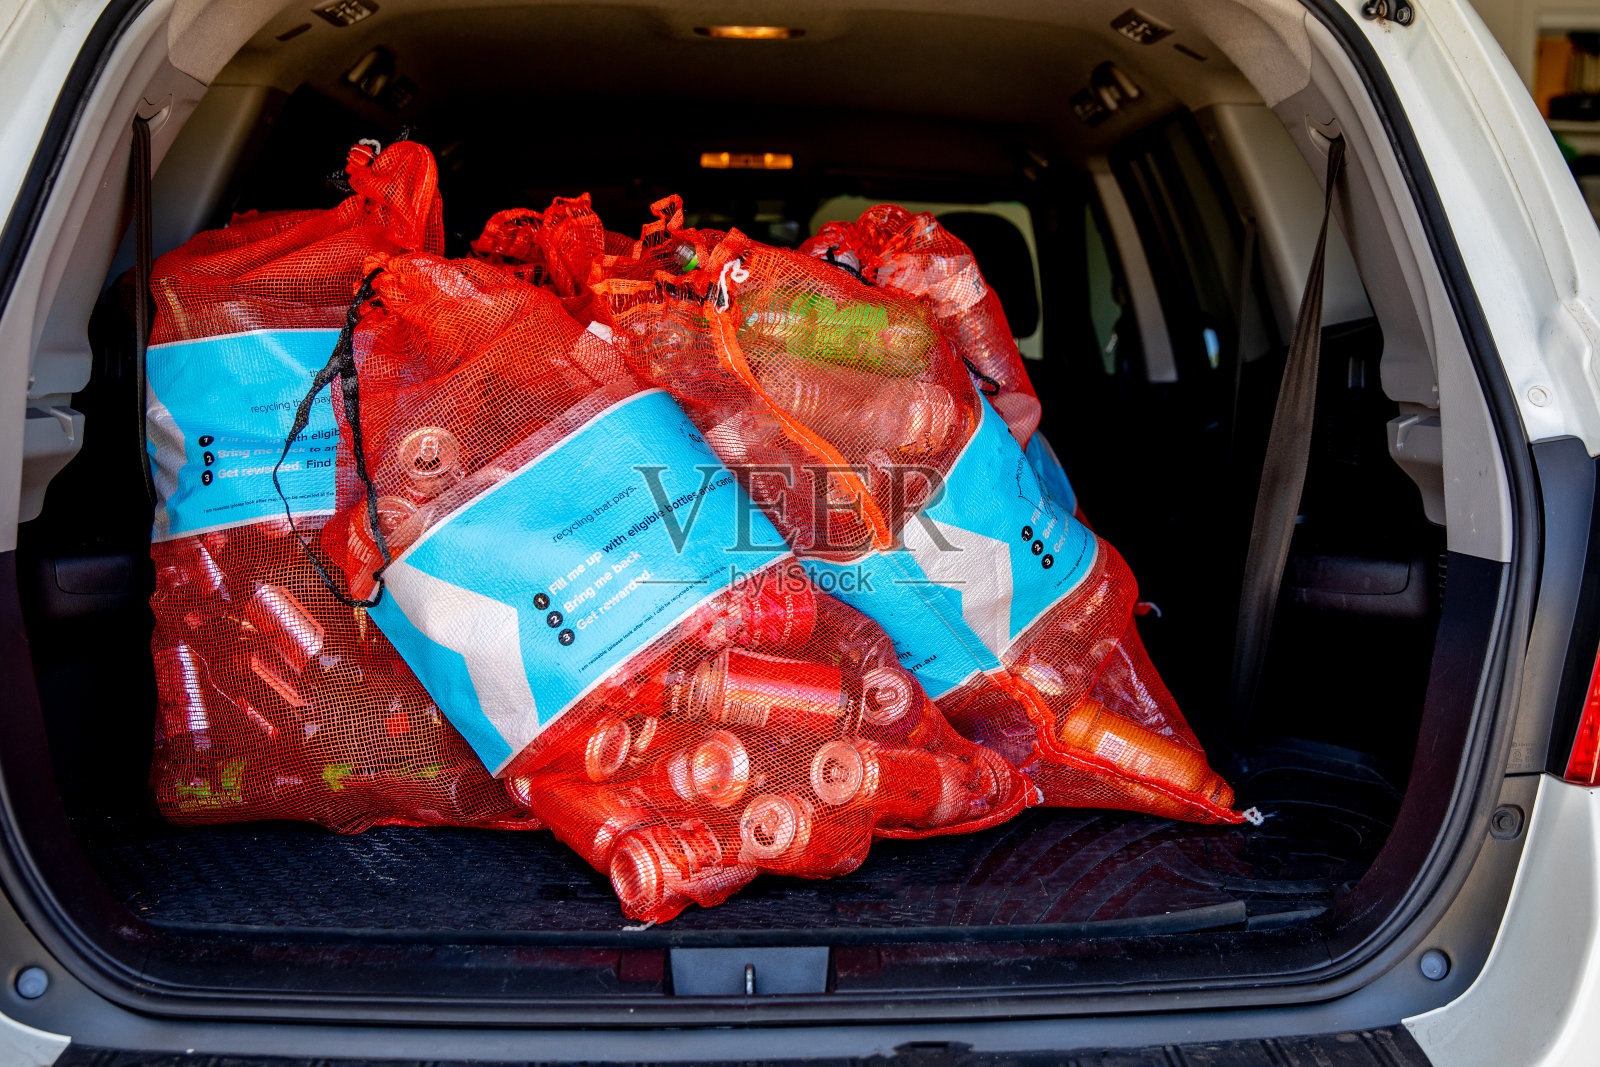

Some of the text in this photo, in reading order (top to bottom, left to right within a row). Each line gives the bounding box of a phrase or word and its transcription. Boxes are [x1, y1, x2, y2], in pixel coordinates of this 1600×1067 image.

[250, 401, 290, 414] recycling
[314, 396, 332, 406] pay
[312, 428, 340, 440] eligib
[218, 448, 250, 458] Bring
[218, 468, 238, 479] Get
[306, 458, 331, 468] Find
[552, 486, 637, 543] recycling that pays.
[1031, 508, 1041, 525] Fill
[548, 577, 568, 596] Fill
[566, 564, 586, 581] me
[585, 552, 602, 566] up
[602, 534, 627, 553] with
[627, 510, 665, 537] eligible
[664, 491, 699, 512] bottles
[699, 482, 716, 496] and
[716, 476, 734, 487] cans
[1042, 517, 1058, 539] Brin
[1054, 535, 1065, 553] Get
[563, 586, 596, 613] Bring
[594, 572, 613, 588] me
[611, 550, 642, 574] back
[576, 610, 599, 630] Get
[598, 569, 654, 614] rewarded.
[671, 587, 689, 602] recycled
